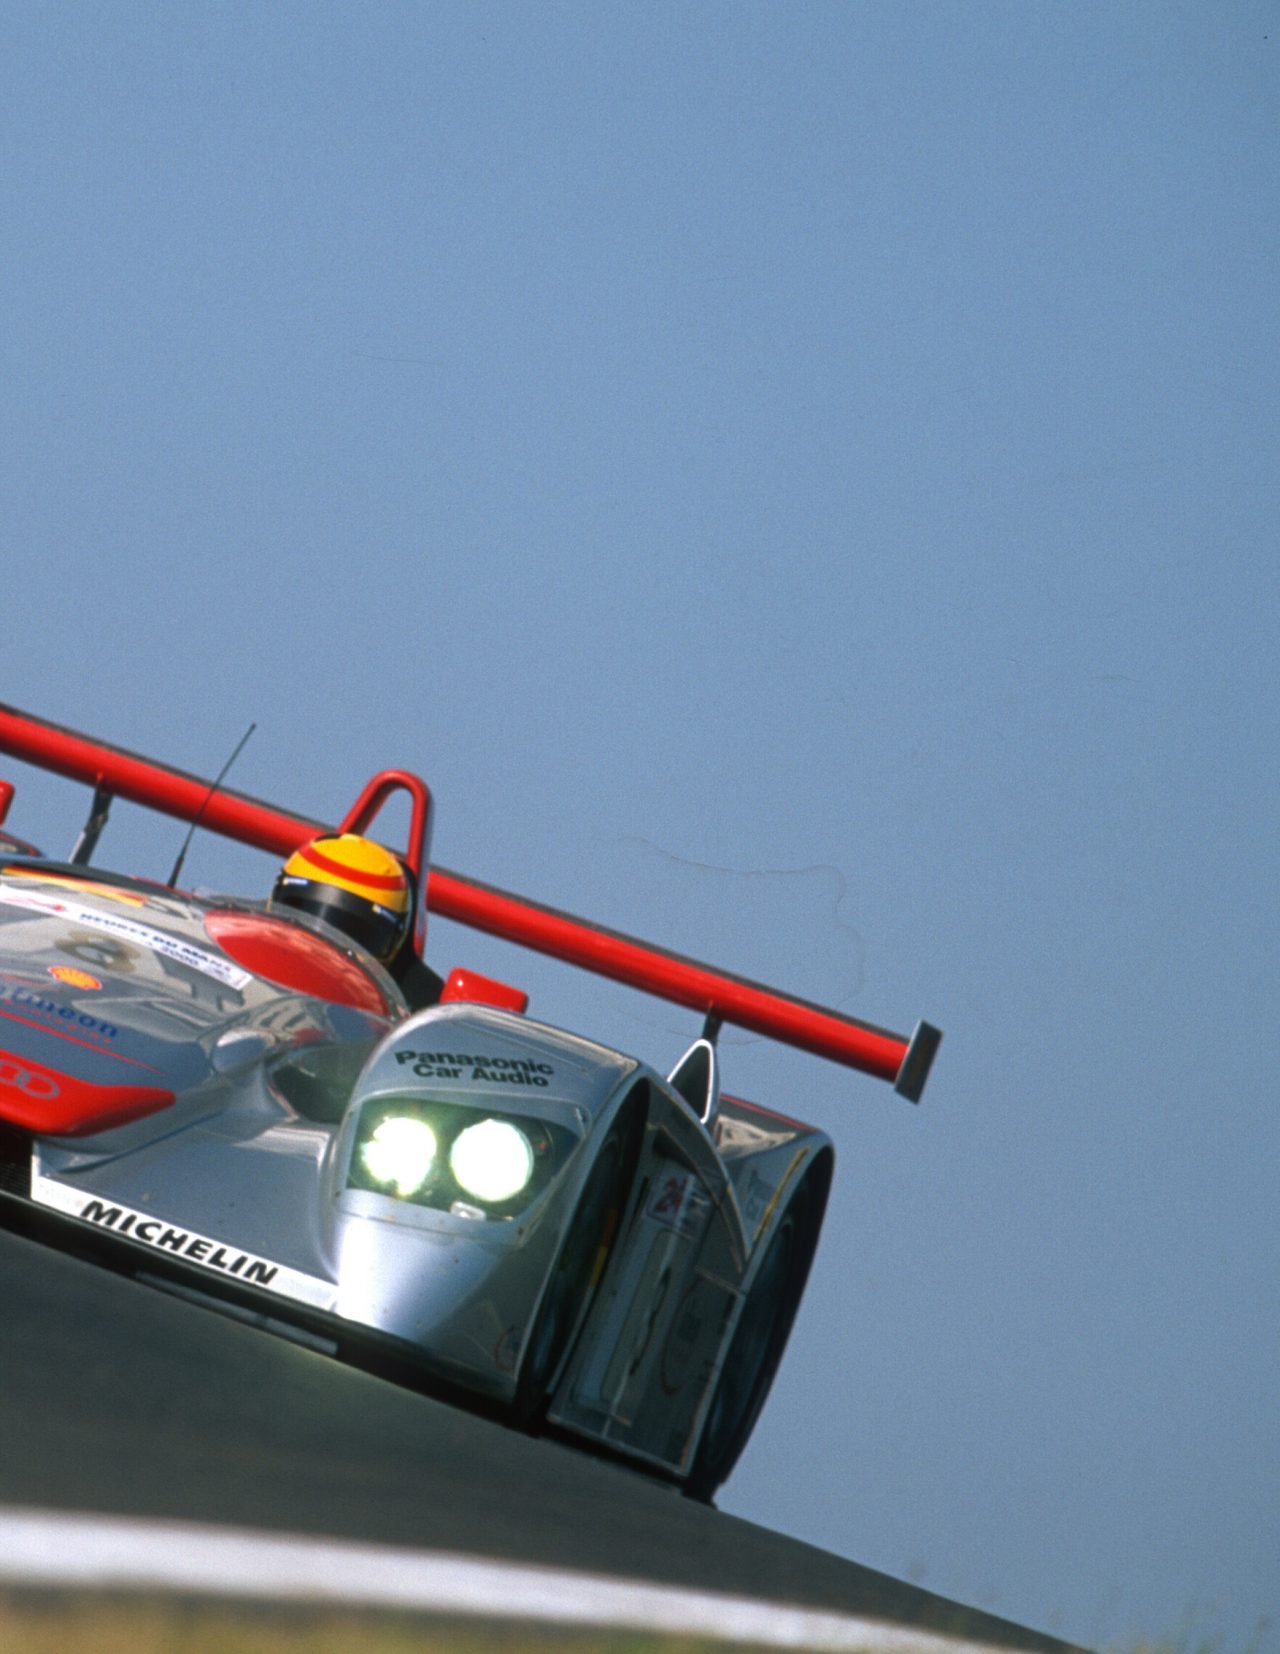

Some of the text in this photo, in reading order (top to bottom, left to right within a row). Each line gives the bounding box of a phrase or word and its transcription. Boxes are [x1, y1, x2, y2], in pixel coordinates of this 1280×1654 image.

[394, 1050, 555, 1076] Panasonic
[413, 1063, 550, 1088] Car Audio
[80, 1200, 279, 1285] MICHELIN
